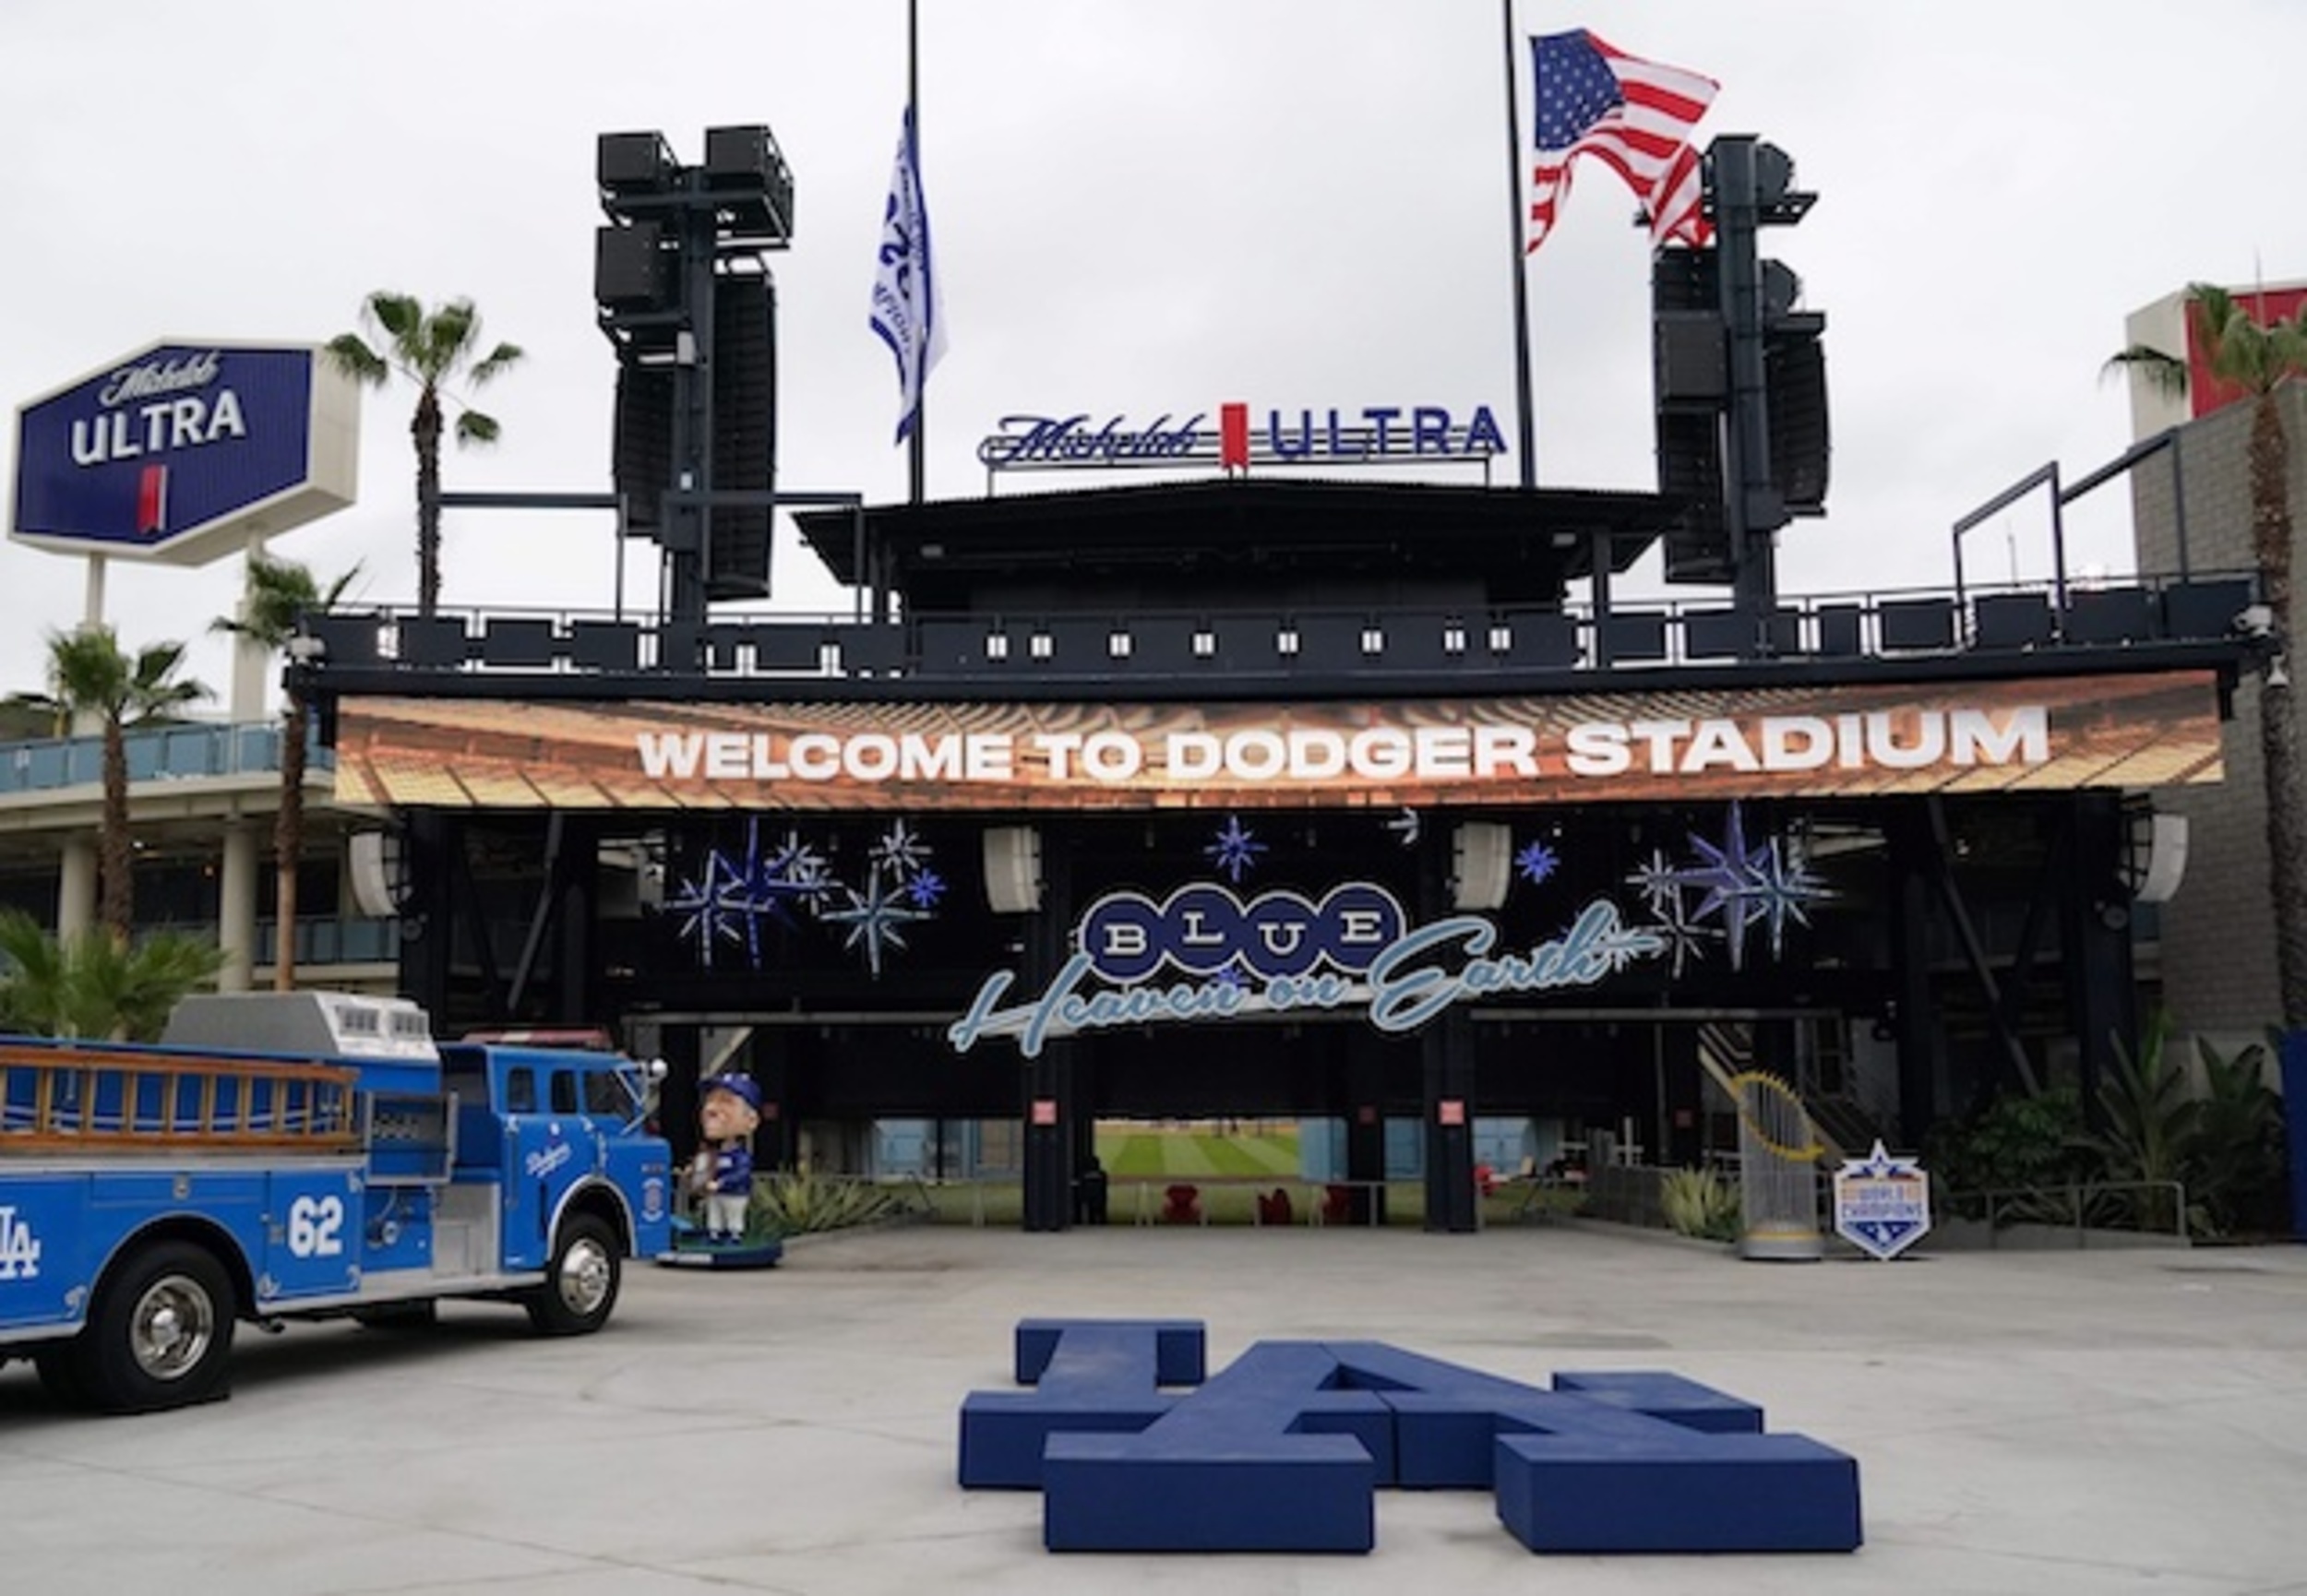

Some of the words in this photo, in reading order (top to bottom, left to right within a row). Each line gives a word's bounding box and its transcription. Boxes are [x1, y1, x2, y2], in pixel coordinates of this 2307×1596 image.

[72, 389, 246, 465] ULTRA
[1269, 406, 1508, 460] ULTRA
[637, 733, 1014, 780] WELCOME
[1034, 732, 1142, 780] TO
[1166, 725, 1543, 780] DODGER
[1567, 706, 2050, 777] STADIUM
[1105, 909, 1382, 955] BLUE
[947, 952, 1246, 1057] Heaven
[1265, 971, 1355, 1010] on
[1368, 899, 1663, 1032] Earth
[288, 1195, 344, 1257] 62
